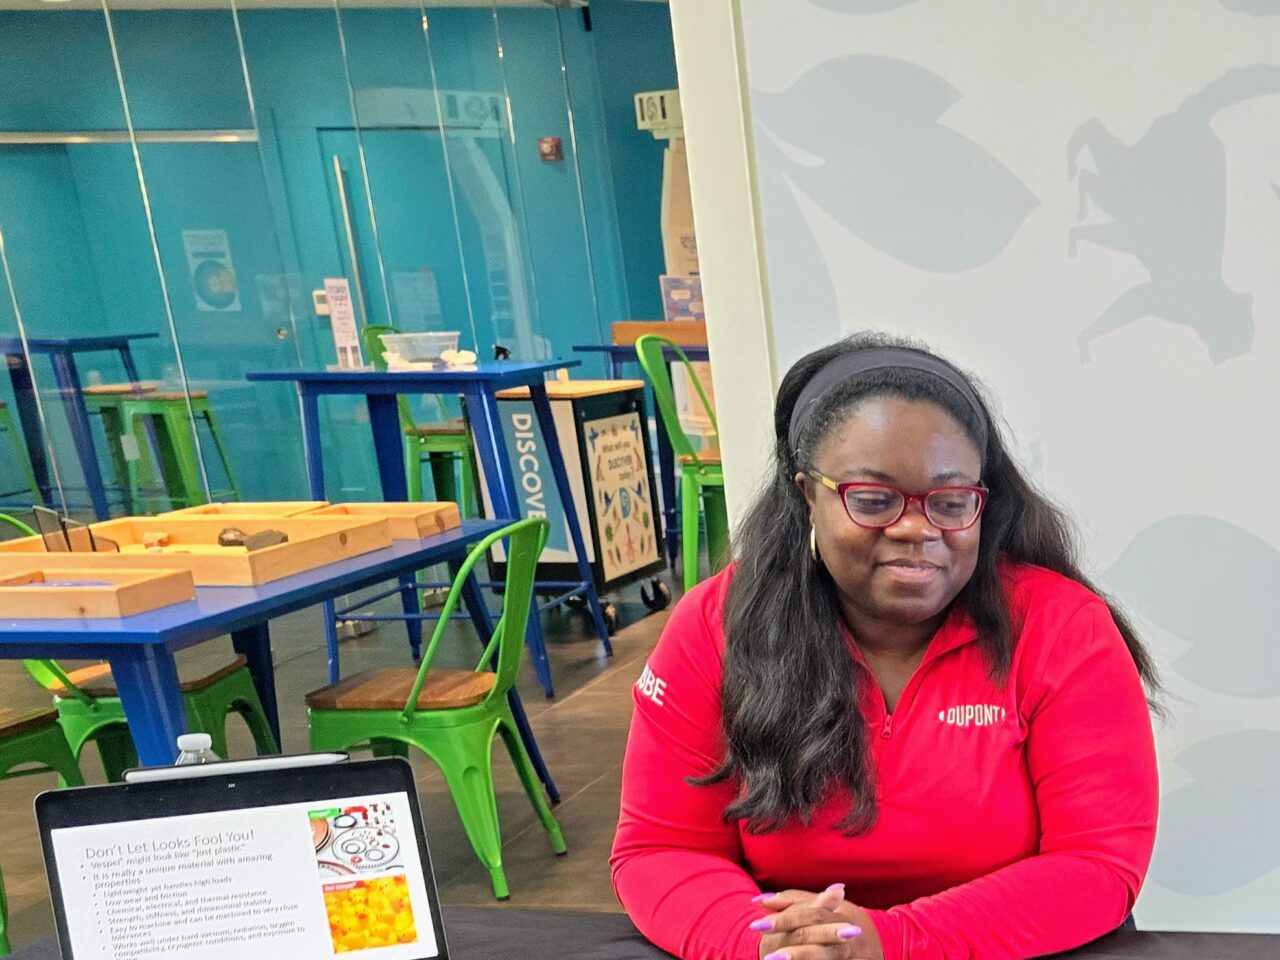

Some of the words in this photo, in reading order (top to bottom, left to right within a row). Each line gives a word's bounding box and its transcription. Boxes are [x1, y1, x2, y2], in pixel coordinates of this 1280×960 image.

[512, 413, 548, 519] DISCOVE
[946, 704, 1001, 727] DUPONT
[127, 842, 148, 855] Let
[152, 836, 191, 851] Looks
[194, 832, 222, 846] Fool
[225, 828, 254, 842] You!
[102, 872, 110, 880] is
[111, 869, 136, 879] really
[145, 865, 176, 874] unique
[178, 859, 214, 870] material
[216, 856, 235, 866] with
[238, 852, 273, 864] amazing
[126, 855, 151, 866] might
[153, 852, 172, 861] look
[94, 878, 142, 890] properties
